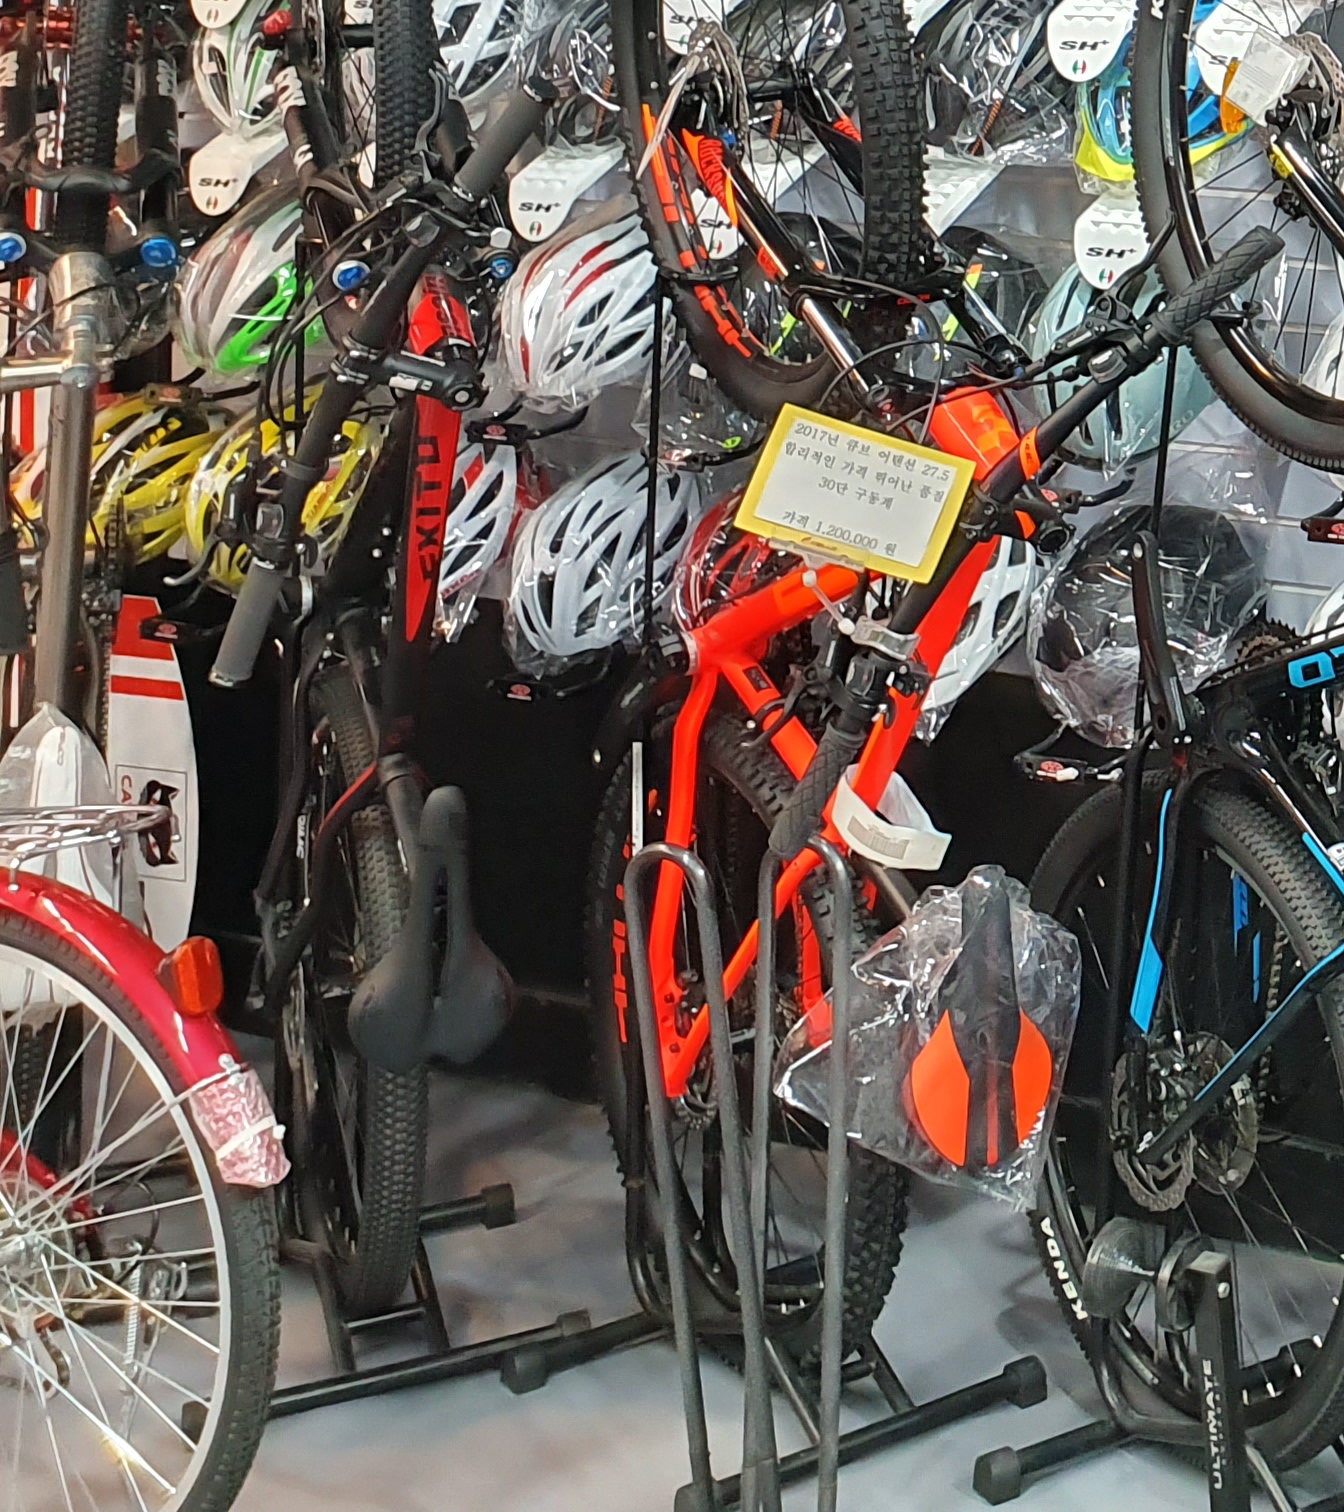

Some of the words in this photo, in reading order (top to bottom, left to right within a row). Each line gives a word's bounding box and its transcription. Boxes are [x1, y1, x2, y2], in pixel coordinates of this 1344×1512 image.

[1059, 40, 1110, 52] SH+
[1095, 246, 1148, 259] SH+
[794, 422, 840, 447] 2017년
[920, 463, 951, 482] 27.5
[841, 461, 869, 479] 가격
[818, 476, 849, 496] 30단
[855, 486, 894, 510] 구동계
[782, 510, 810, 529] 가격
[815, 520, 878, 550] 1.200.000
[884, 542, 898, 557] 원
[1040, 1215, 1089, 1322] KENDA
[1201, 1358, 1224, 1491] ULTIMATE
